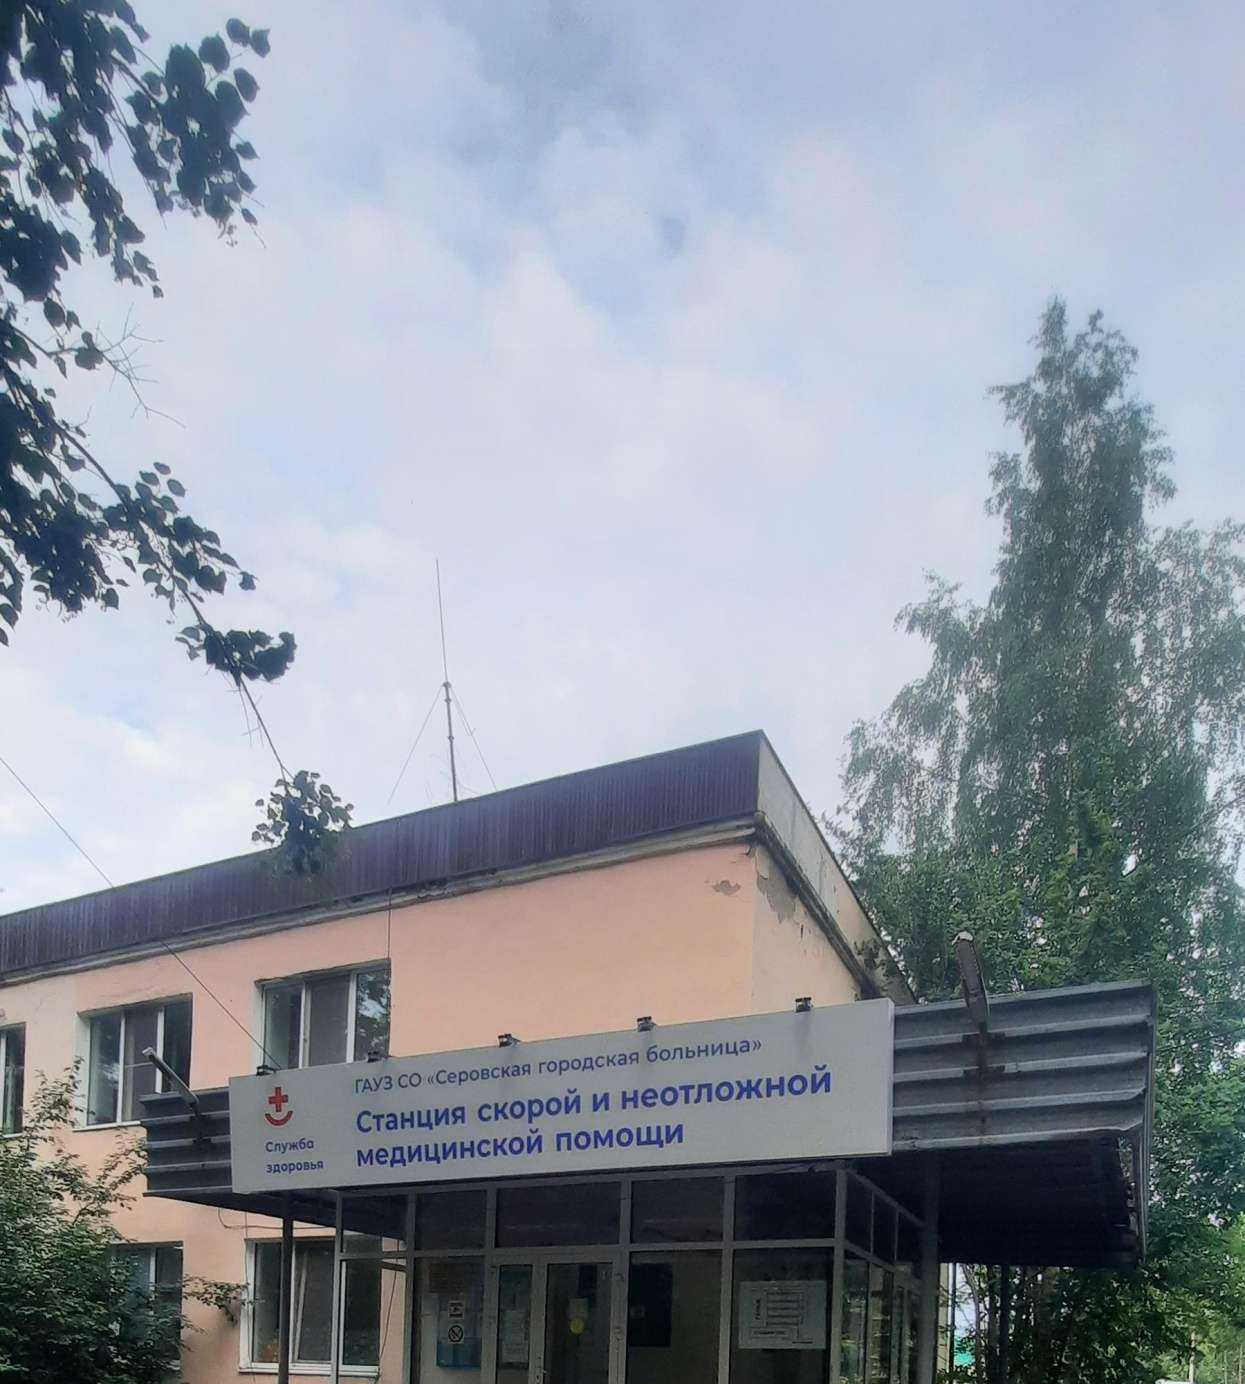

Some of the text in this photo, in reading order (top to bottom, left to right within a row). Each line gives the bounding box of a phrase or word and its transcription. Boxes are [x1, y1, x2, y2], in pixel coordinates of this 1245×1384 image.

[355, 1038, 762, 1094] ГАУЗ СО «Серовская городская больница»
[356, 1064, 831, 1133] Станция скорой и неотложной
[265, 1138, 315, 1154] Служба
[266, 1160, 324, 1175] здоровья
[356, 1124, 684, 1168] медицинской помощи
